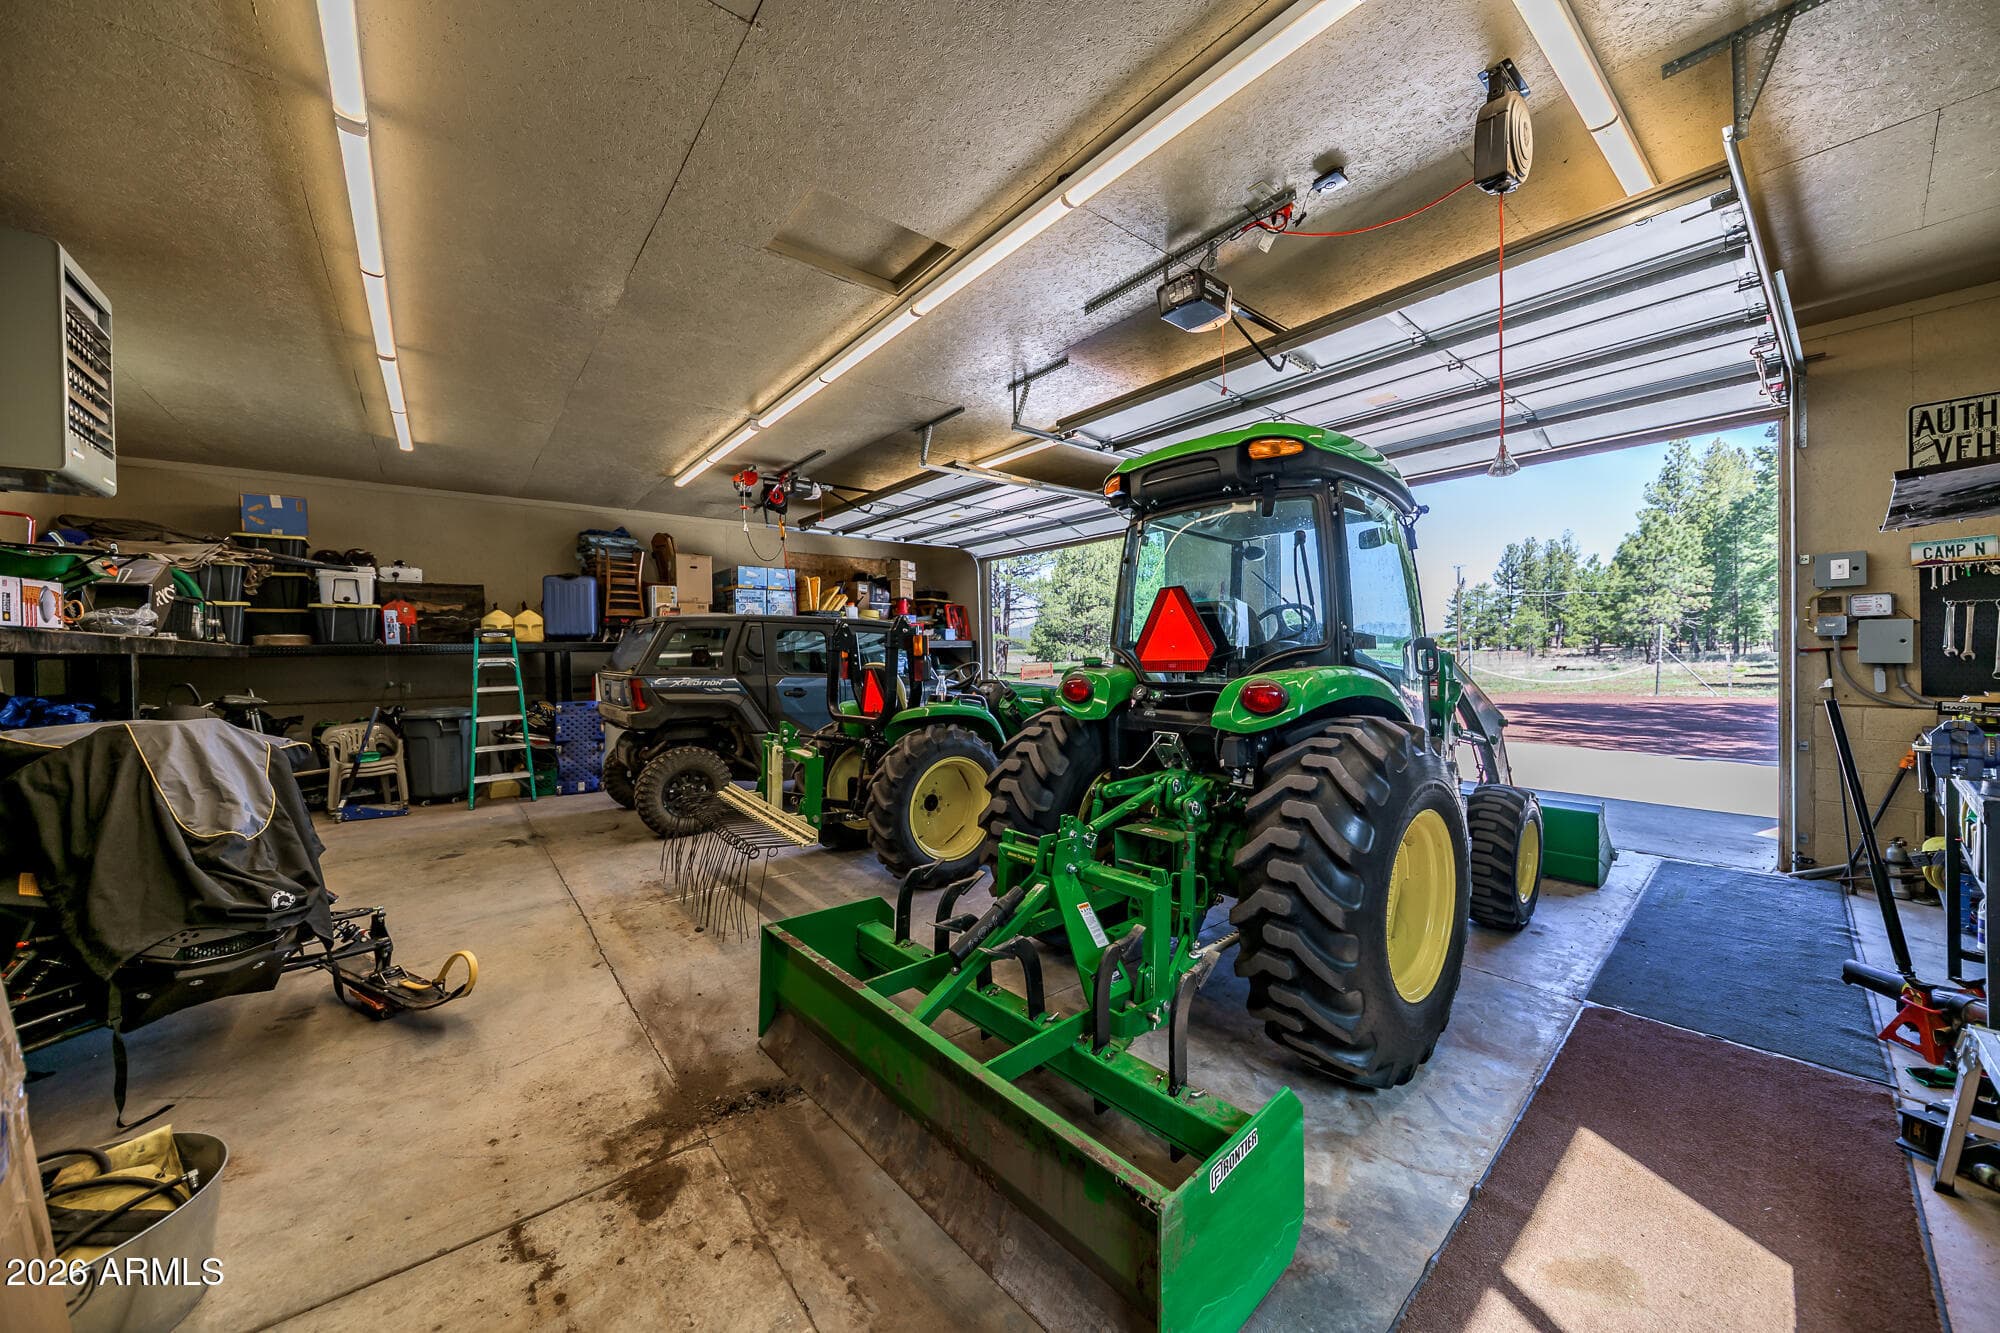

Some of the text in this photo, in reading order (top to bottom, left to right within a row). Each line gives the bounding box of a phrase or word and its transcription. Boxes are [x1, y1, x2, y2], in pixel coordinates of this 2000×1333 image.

[1923, 542, 1986, 560] CAMP N
[1211, 1130, 1258, 1191] FRONTIER
